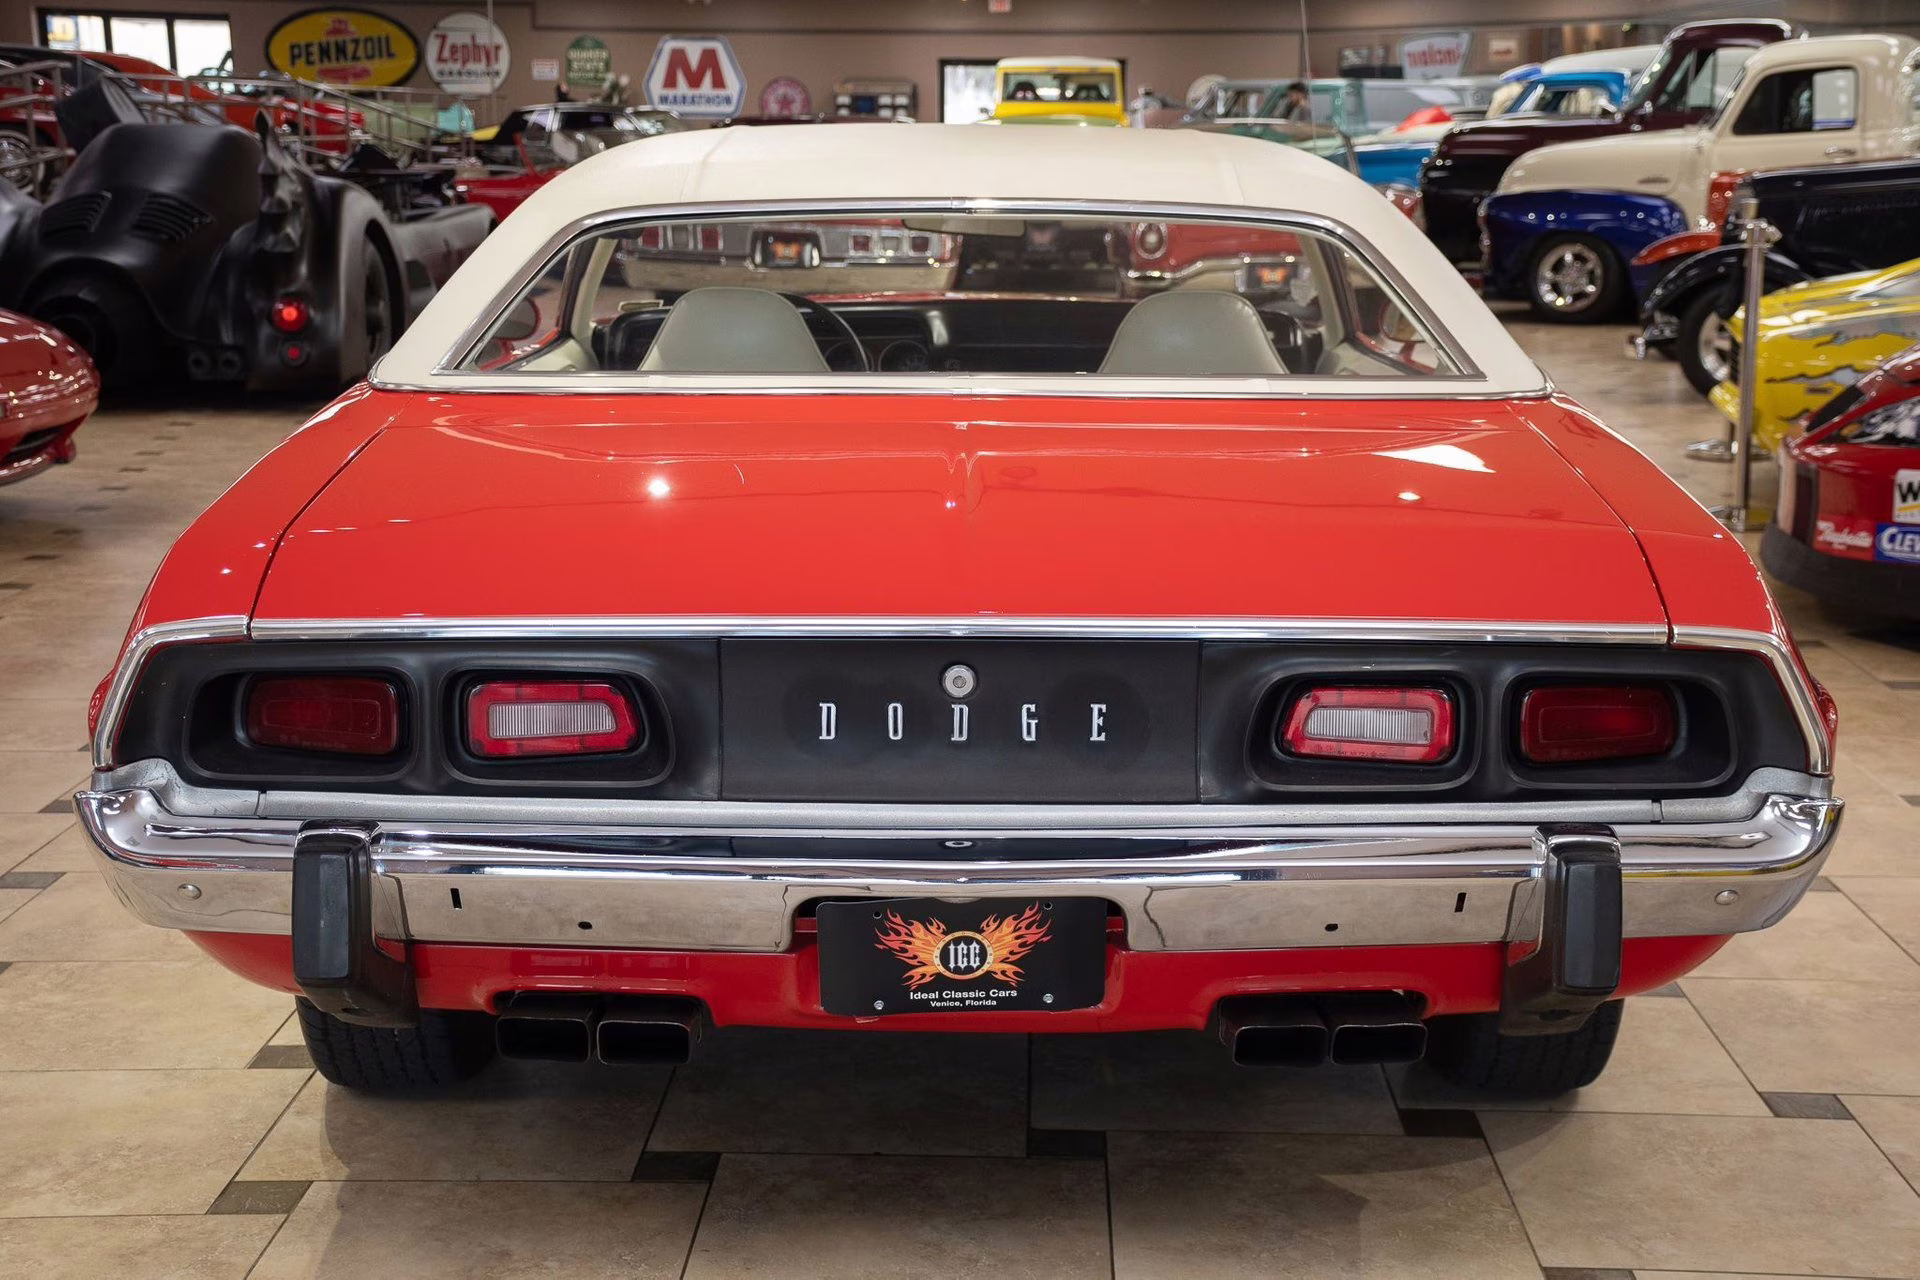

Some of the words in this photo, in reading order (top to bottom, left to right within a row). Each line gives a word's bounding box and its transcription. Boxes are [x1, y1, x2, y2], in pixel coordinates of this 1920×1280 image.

[289, 35, 396, 66] PENNZOIL
[435, 33, 503, 68] Zephyr
[571, 61, 604, 72] STATE
[662, 48, 727, 90] M
[659, 93, 733, 107] MARATHON
[819, 702, 1107, 741] DODGE
[910, 991, 939, 1000] Ideal
[942, 989, 986, 999] Classic
[989, 989, 1018, 998] Cars
[965, 999, 997, 1007] Florida
